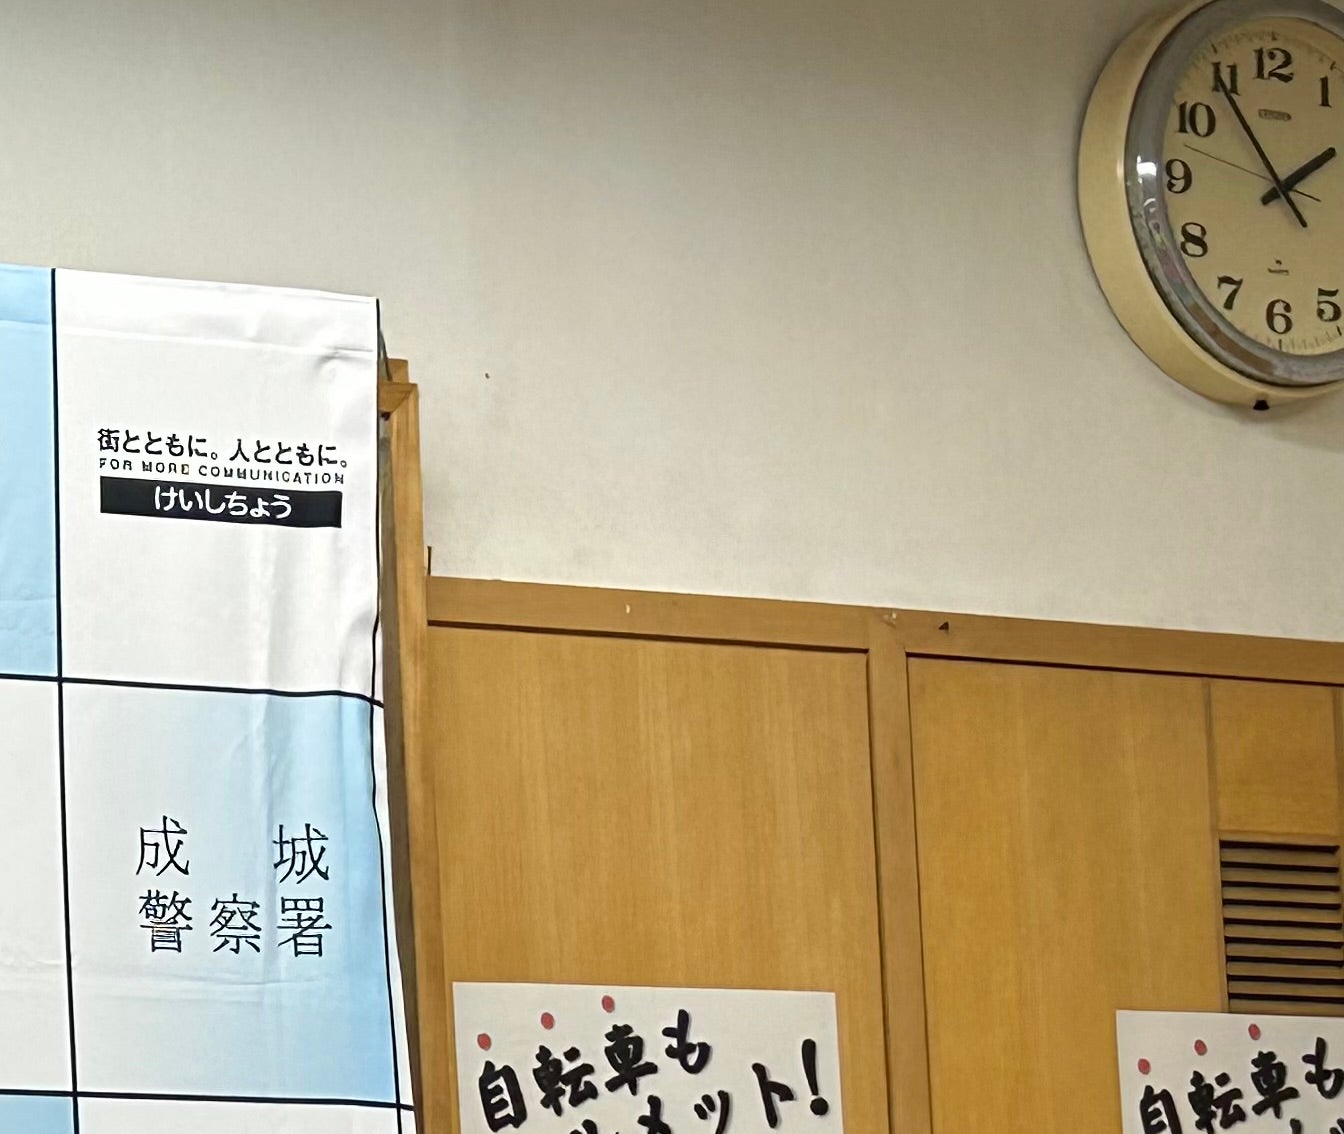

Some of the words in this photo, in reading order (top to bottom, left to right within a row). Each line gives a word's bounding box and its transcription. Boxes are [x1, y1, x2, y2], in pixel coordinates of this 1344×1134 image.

[1212, 60, 1240, 96] 11
[1254, 47, 1293, 83] 12
[1318, 75, 1332, 108] 1
[1178, 101, 1216, 138] 10
[1165, 159, 1193, 194] 9
[1180, 222, 1208, 258] 8
[1217, 276, 1243, 310] 7
[1317, 288, 1342, 322] 5
[1265, 299, 1292, 334] 6
[97, 429, 347, 468] 街とともに。人とともに。
[100, 458, 132, 470] FOR
[142, 461, 189, 475] MORE
[199, 465, 343, 484] COMMUNICATION
[155, 486, 291, 518] けいしちょう
[139, 889, 332, 957] 警察署
[478, 1010, 711, 1132] 自転車も
